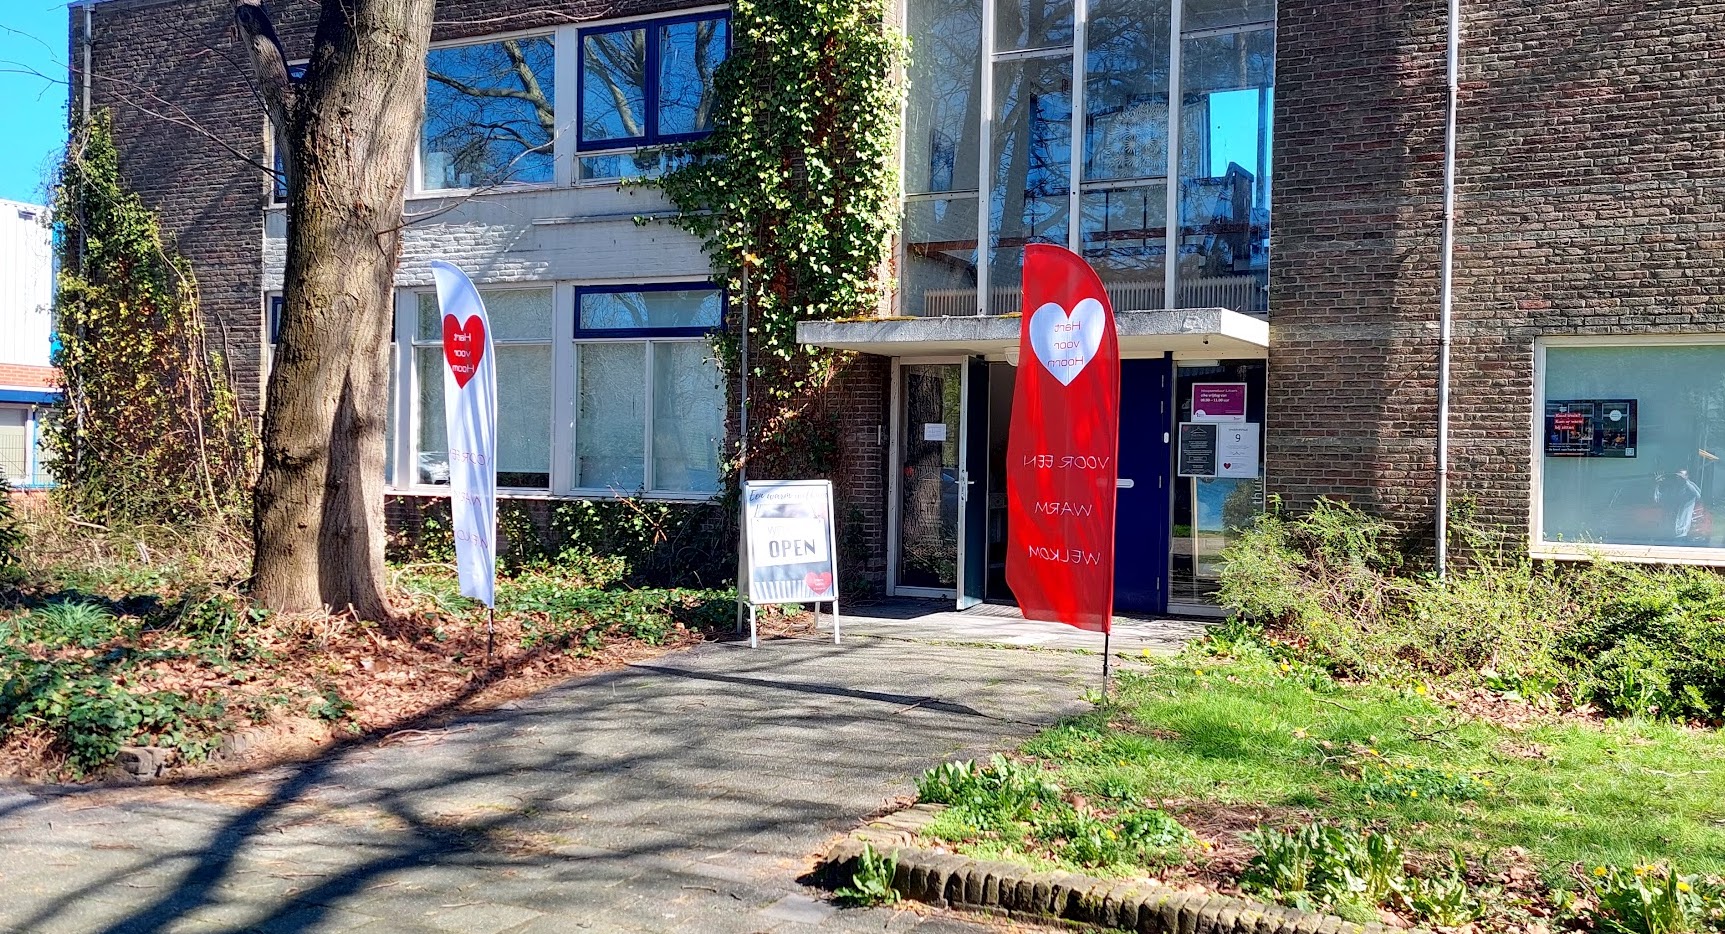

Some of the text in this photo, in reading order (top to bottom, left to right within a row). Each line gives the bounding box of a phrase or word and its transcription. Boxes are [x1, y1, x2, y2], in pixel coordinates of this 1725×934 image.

[1235, 433, 1241, 443] 9
[749, 489, 764, 502] Een
[1252, 476, 1263, 505] thuis
[769, 539, 816, 558] OPEN
